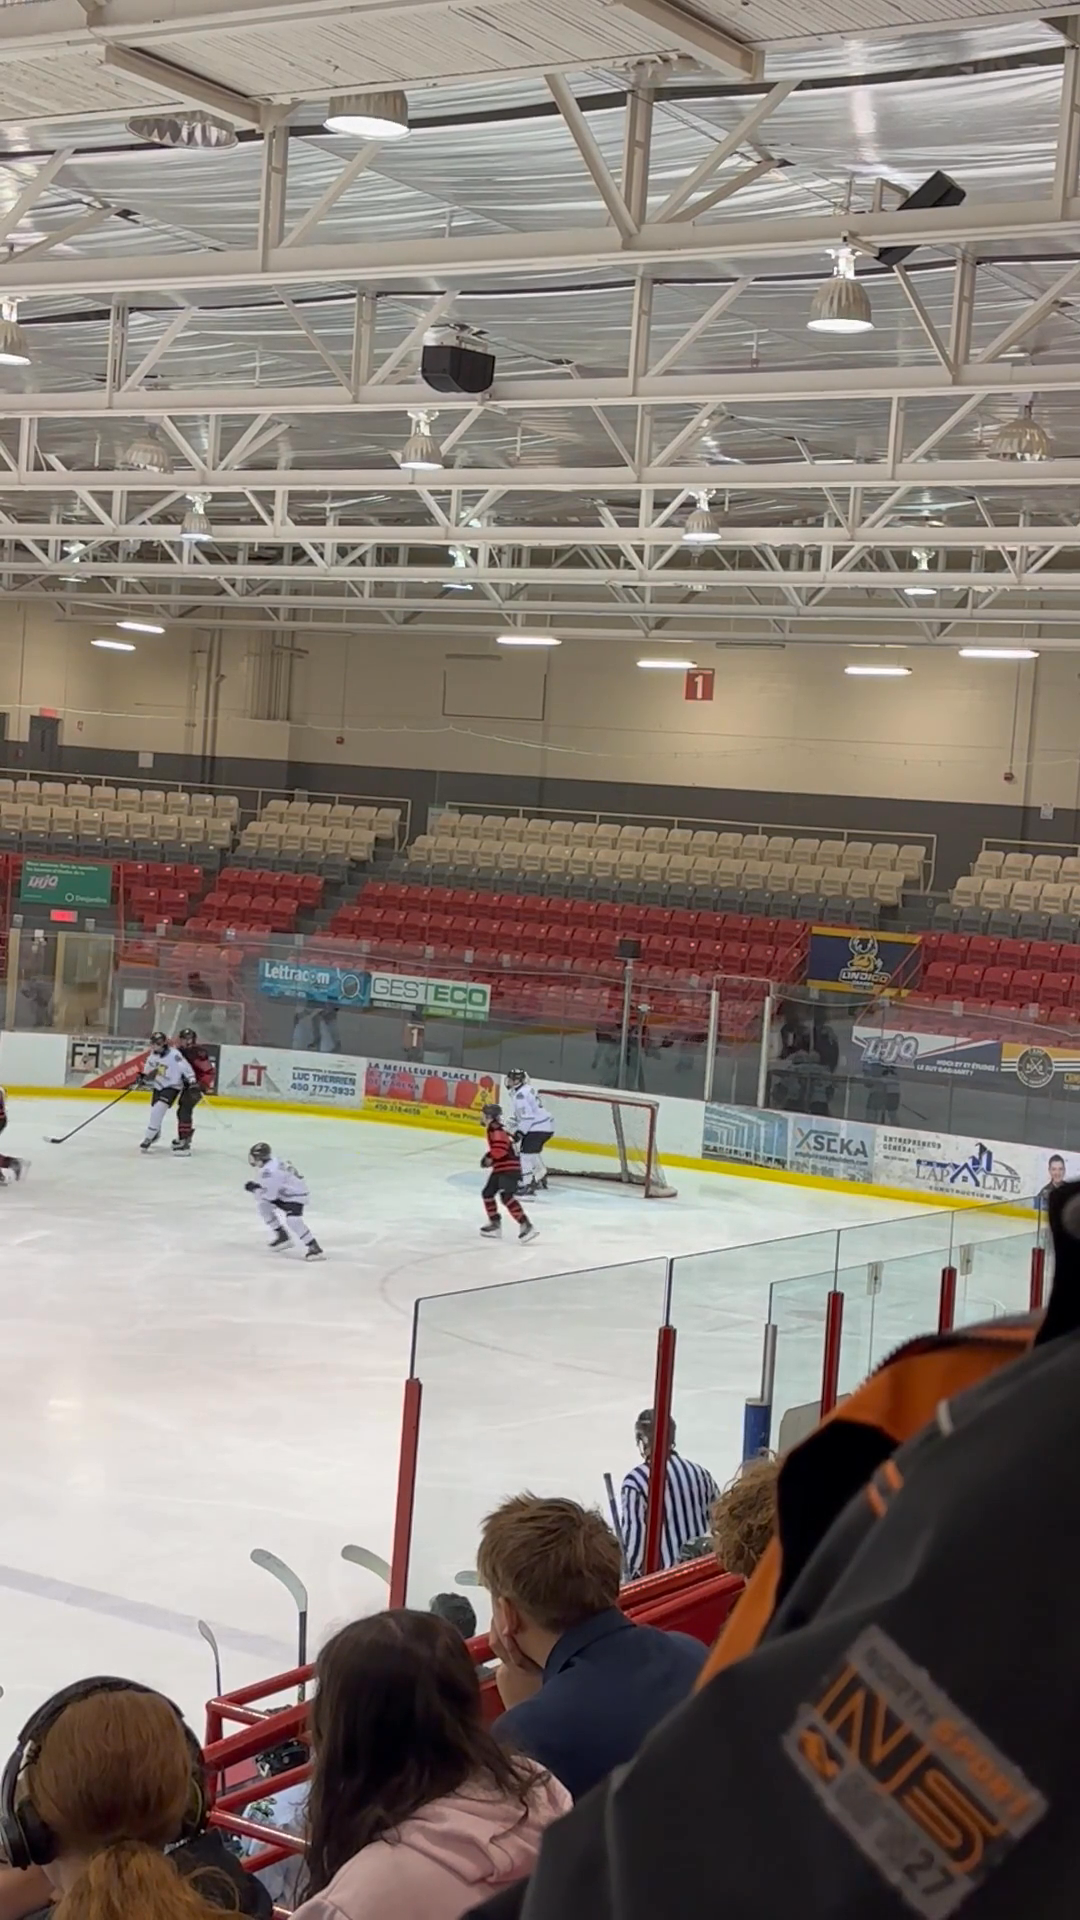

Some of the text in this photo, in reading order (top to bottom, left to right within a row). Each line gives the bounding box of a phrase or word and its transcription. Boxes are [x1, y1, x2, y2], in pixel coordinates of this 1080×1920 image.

[694, 674, 703, 699] 1
[264, 961, 331, 985] Lettracom
[373, 977, 488, 1007] GESTECO
[242, 1064, 268, 1086] LT
[292, 1072, 357, 1086] LUC THERRIEN
[383, 1063, 439, 1077] MEILLEURE
[442, 1071, 470, 1081] PLACE
[290, 1082, 309, 1092] 450
[796, 1127, 869, 1159] XSEKA
[902, 1848, 955, 1897] 27
